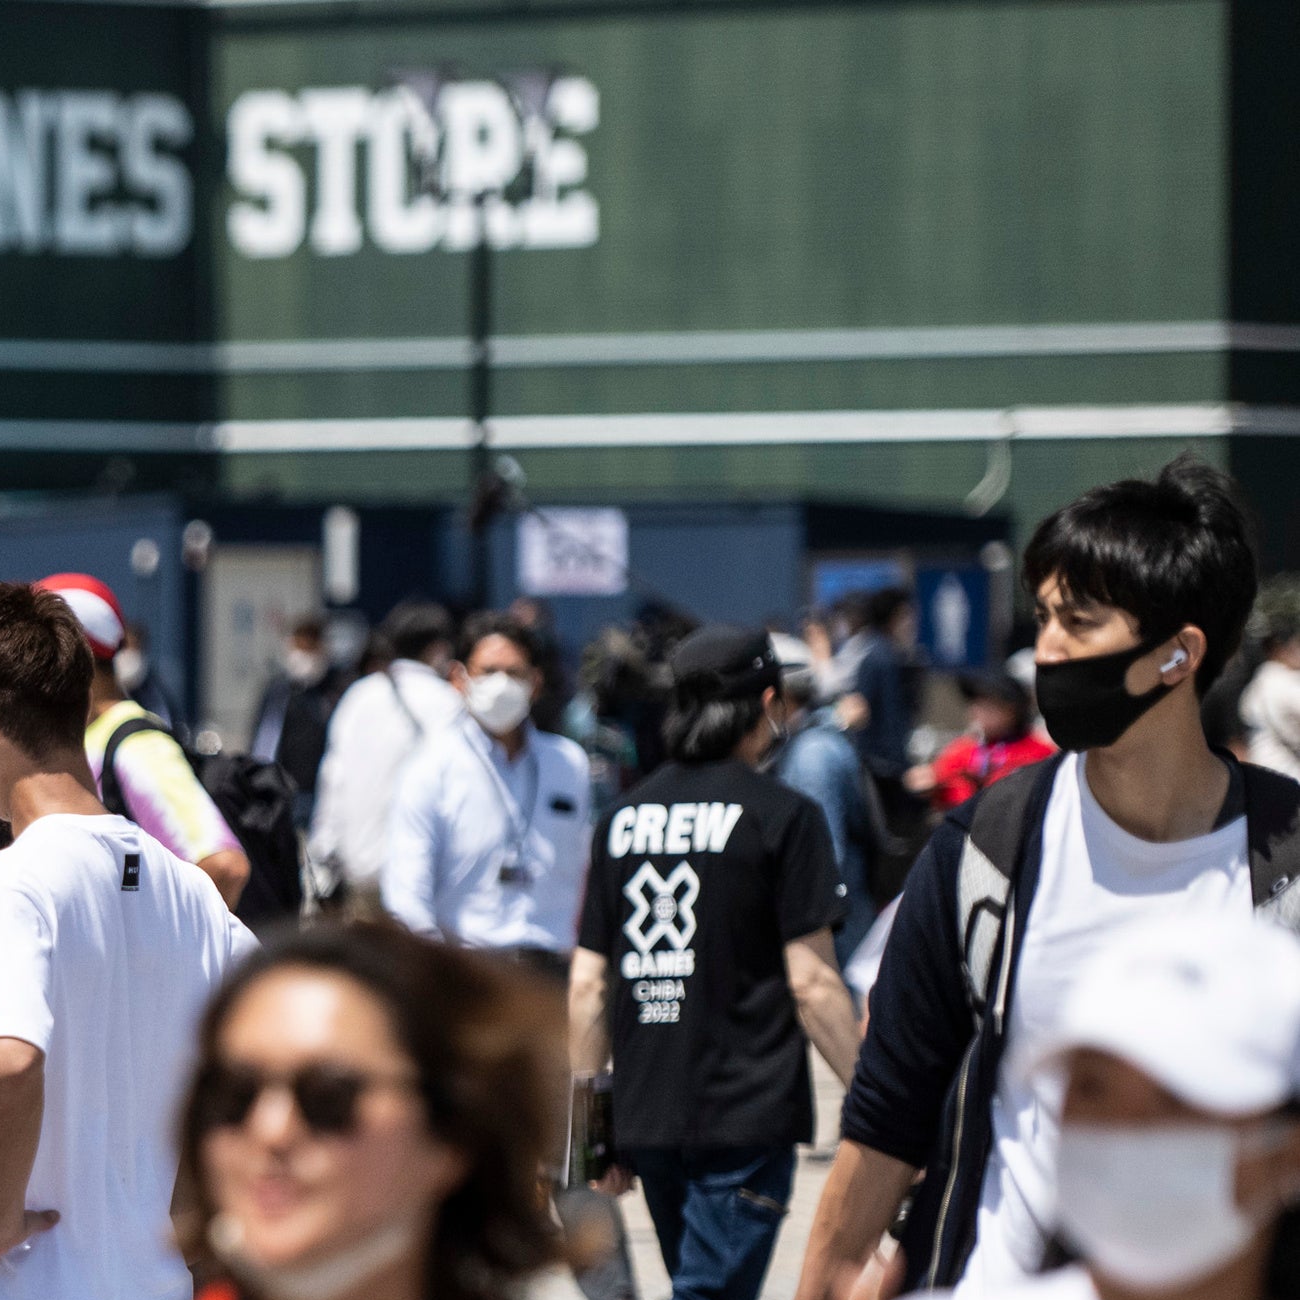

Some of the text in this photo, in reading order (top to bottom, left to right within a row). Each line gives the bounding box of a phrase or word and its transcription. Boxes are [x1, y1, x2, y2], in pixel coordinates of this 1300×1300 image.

[226, 76, 600, 258] STORE
[608, 802, 744, 858] CREW
[621, 949, 696, 979] GAMES
[632, 979, 686, 1001] CHIBA
[638, 1001, 680, 1024] 2022
